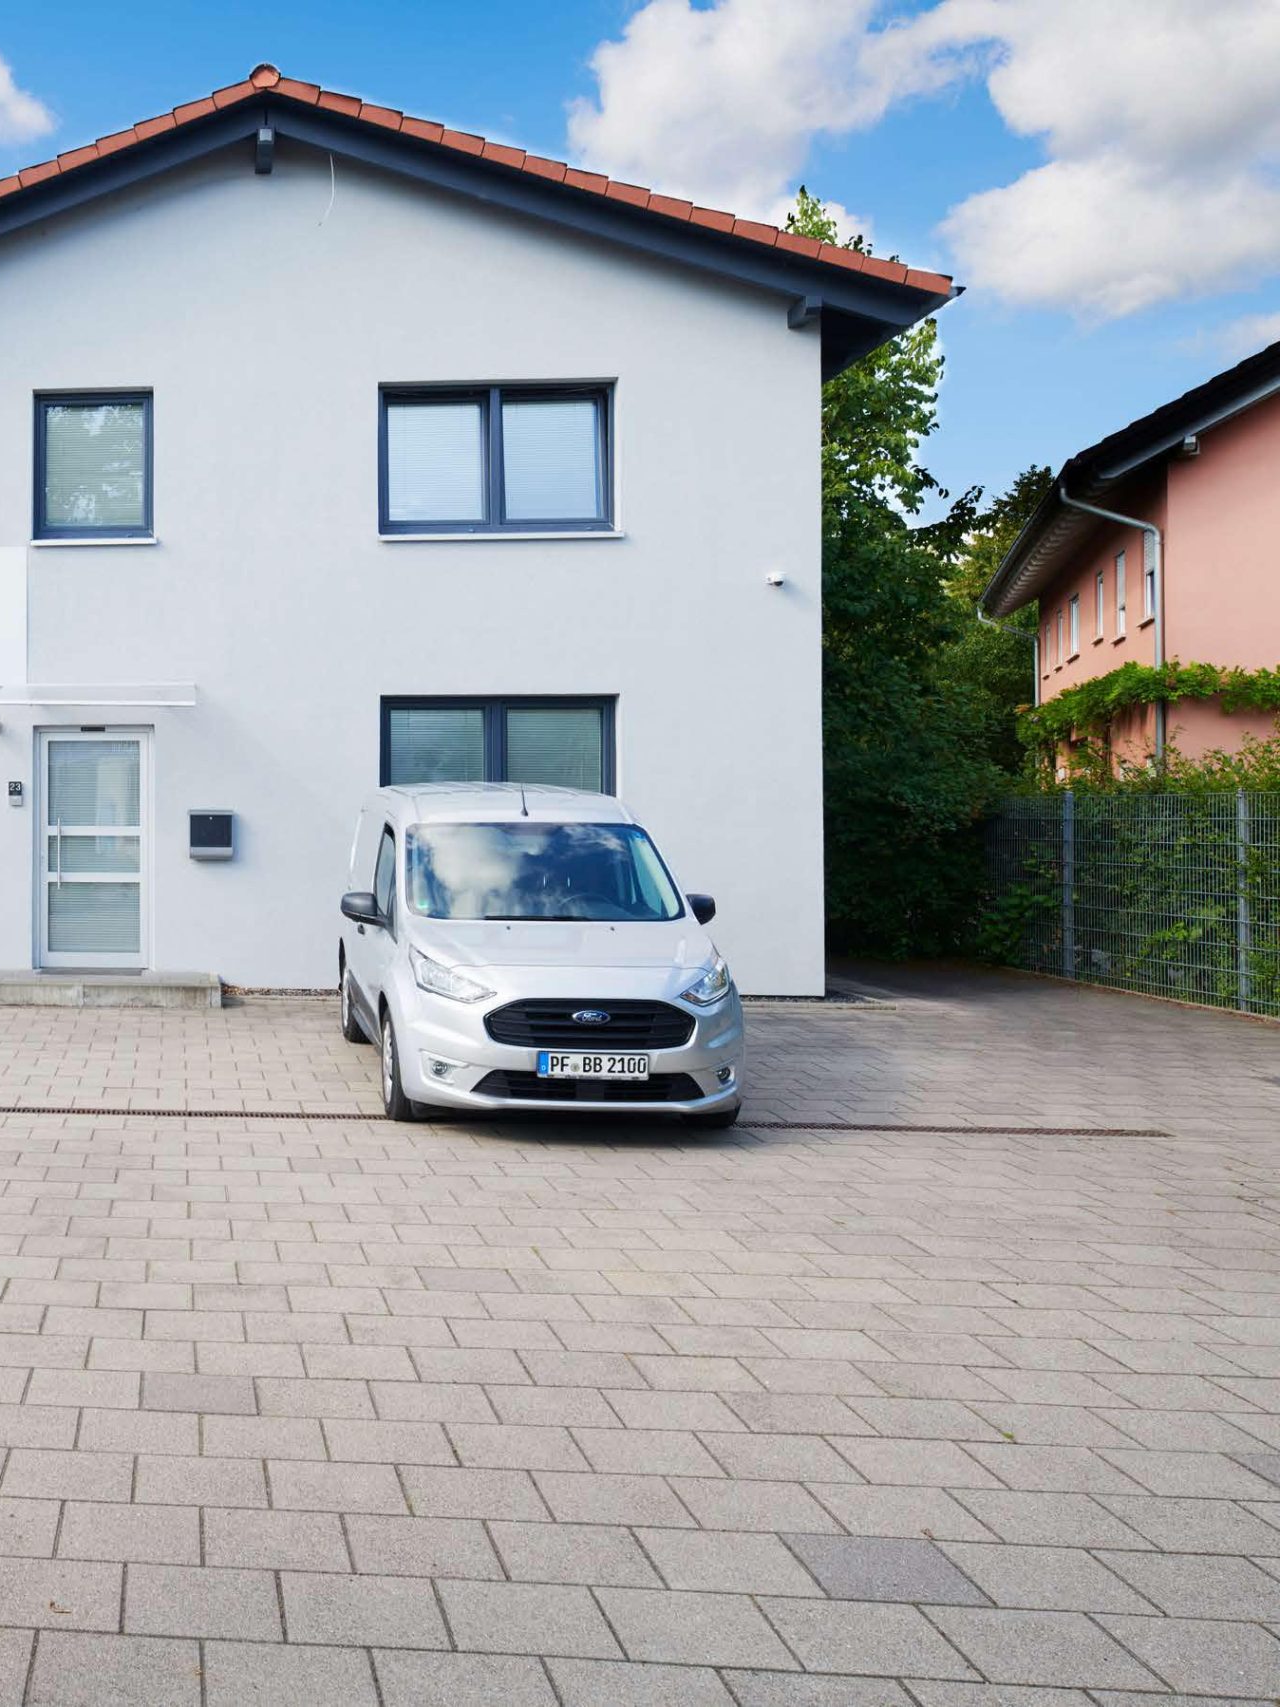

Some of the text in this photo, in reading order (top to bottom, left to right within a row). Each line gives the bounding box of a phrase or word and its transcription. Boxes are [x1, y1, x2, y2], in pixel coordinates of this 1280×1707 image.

[9, 782, 21, 791] 23
[550, 1056, 570, 1072] PF
[582, 1057, 602, 1073] BB
[607, 1058, 646, 1074] 2100
